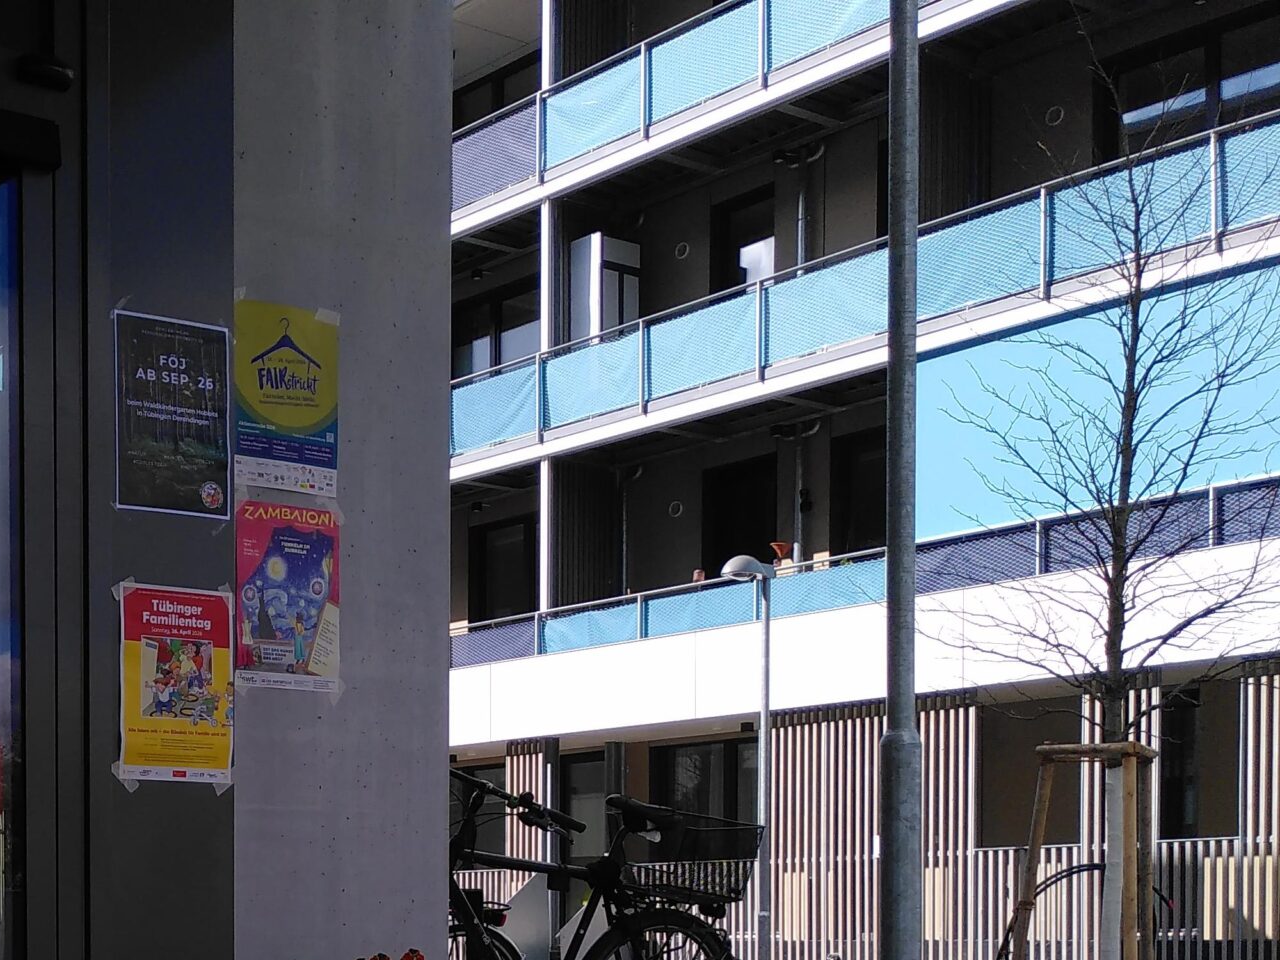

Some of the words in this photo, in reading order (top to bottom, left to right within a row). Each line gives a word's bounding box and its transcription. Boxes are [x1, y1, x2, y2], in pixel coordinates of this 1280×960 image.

[159, 354, 186, 370] FÖJ
[135, 367, 156, 381] AB
[161, 371, 193, 387] SEP.
[197, 377, 214, 390] 26
[143, 410, 172, 421] Tübingen
[172, 414, 210, 426] Derendingen
[151, 599, 202, 616] Tübinger
[142, 611, 211, 631] Familientag
